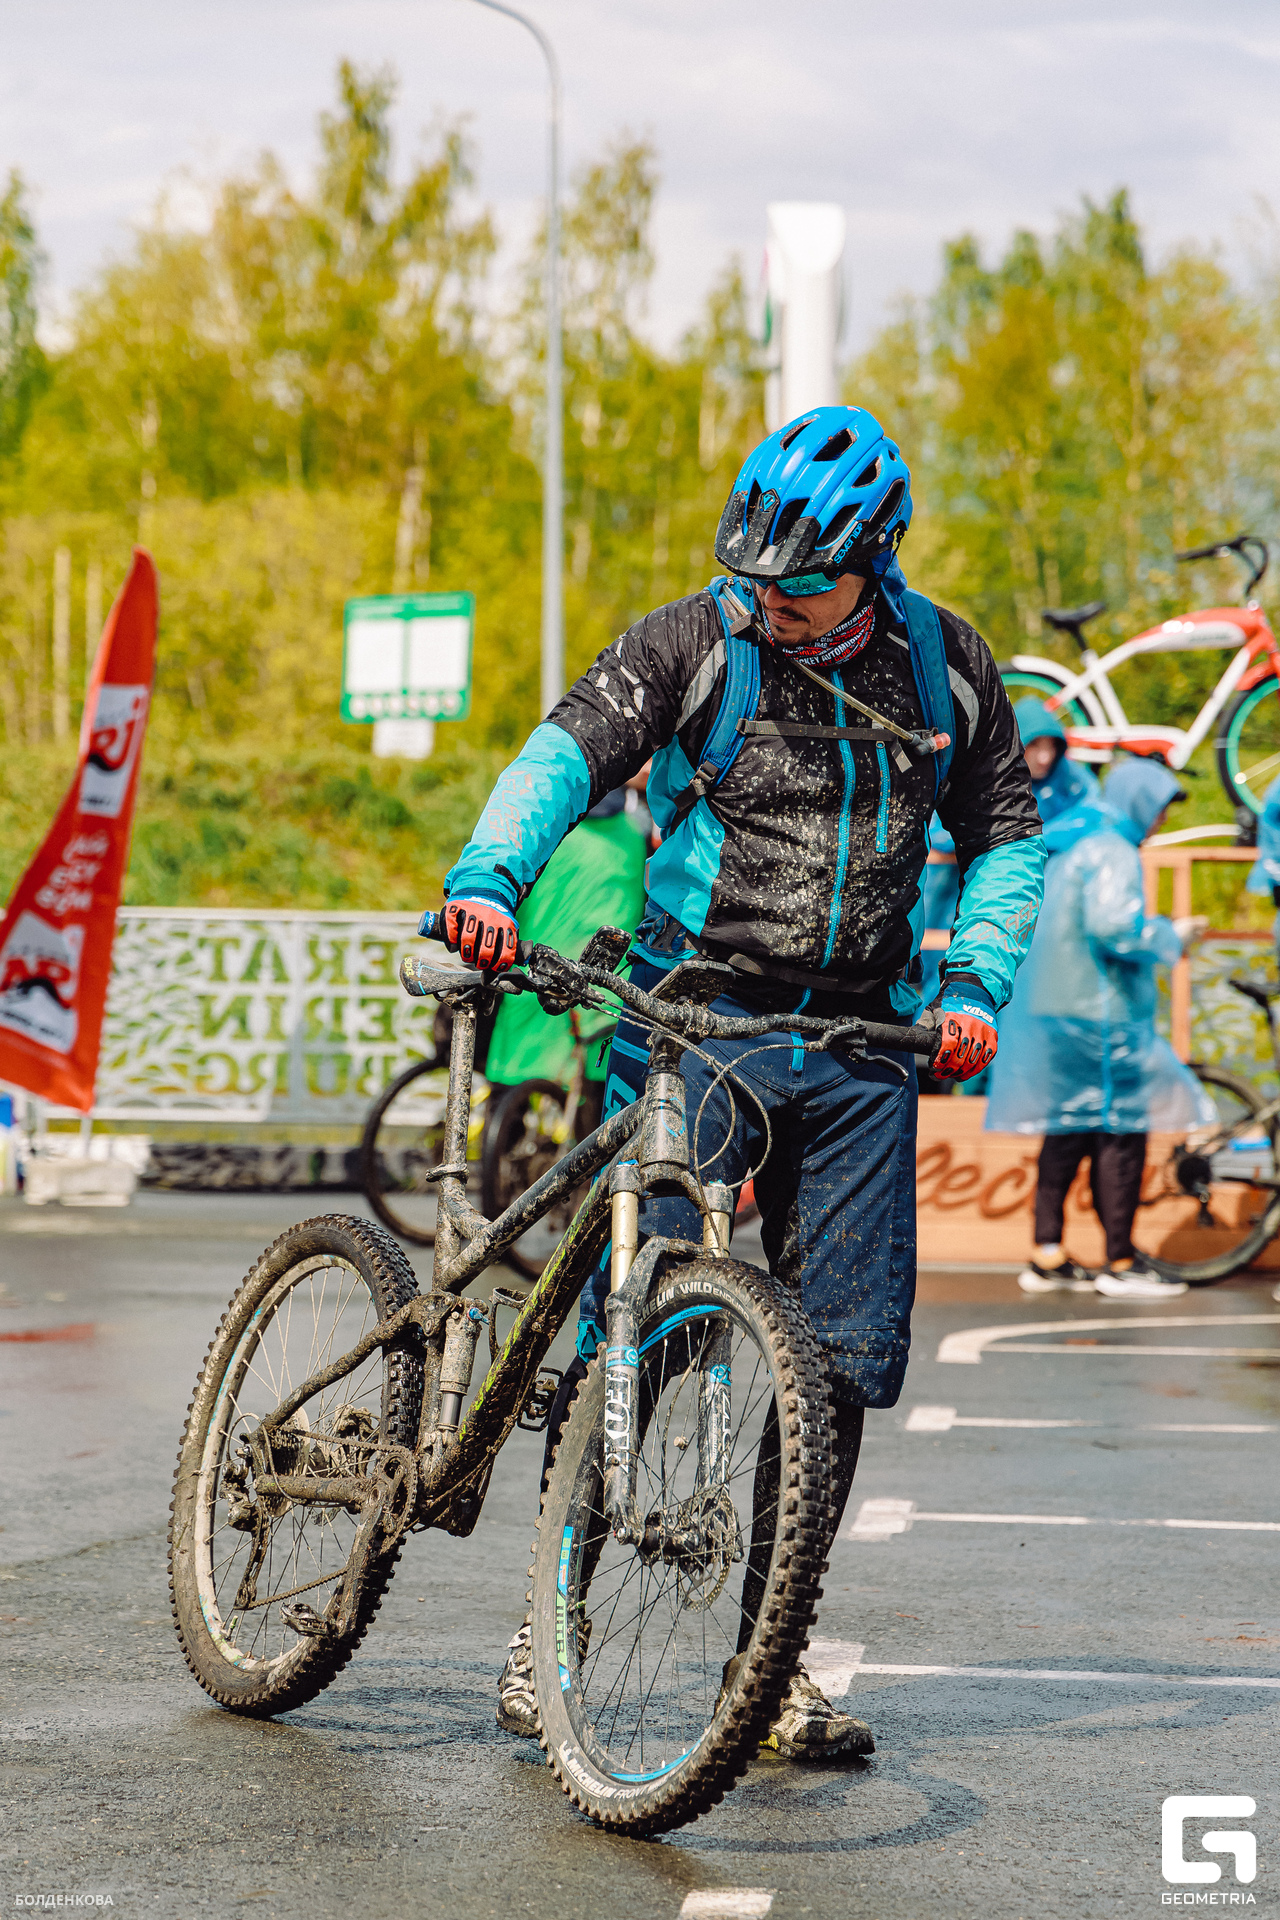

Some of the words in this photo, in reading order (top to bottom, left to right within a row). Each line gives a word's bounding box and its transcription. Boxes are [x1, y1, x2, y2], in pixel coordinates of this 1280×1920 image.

[679, 1281, 713, 1295] WILD
[712, 1287, 750, 1321] ENDURO
[604, 1371, 632, 1474] FOX
[567, 1757, 617, 1798] MICHELIN
